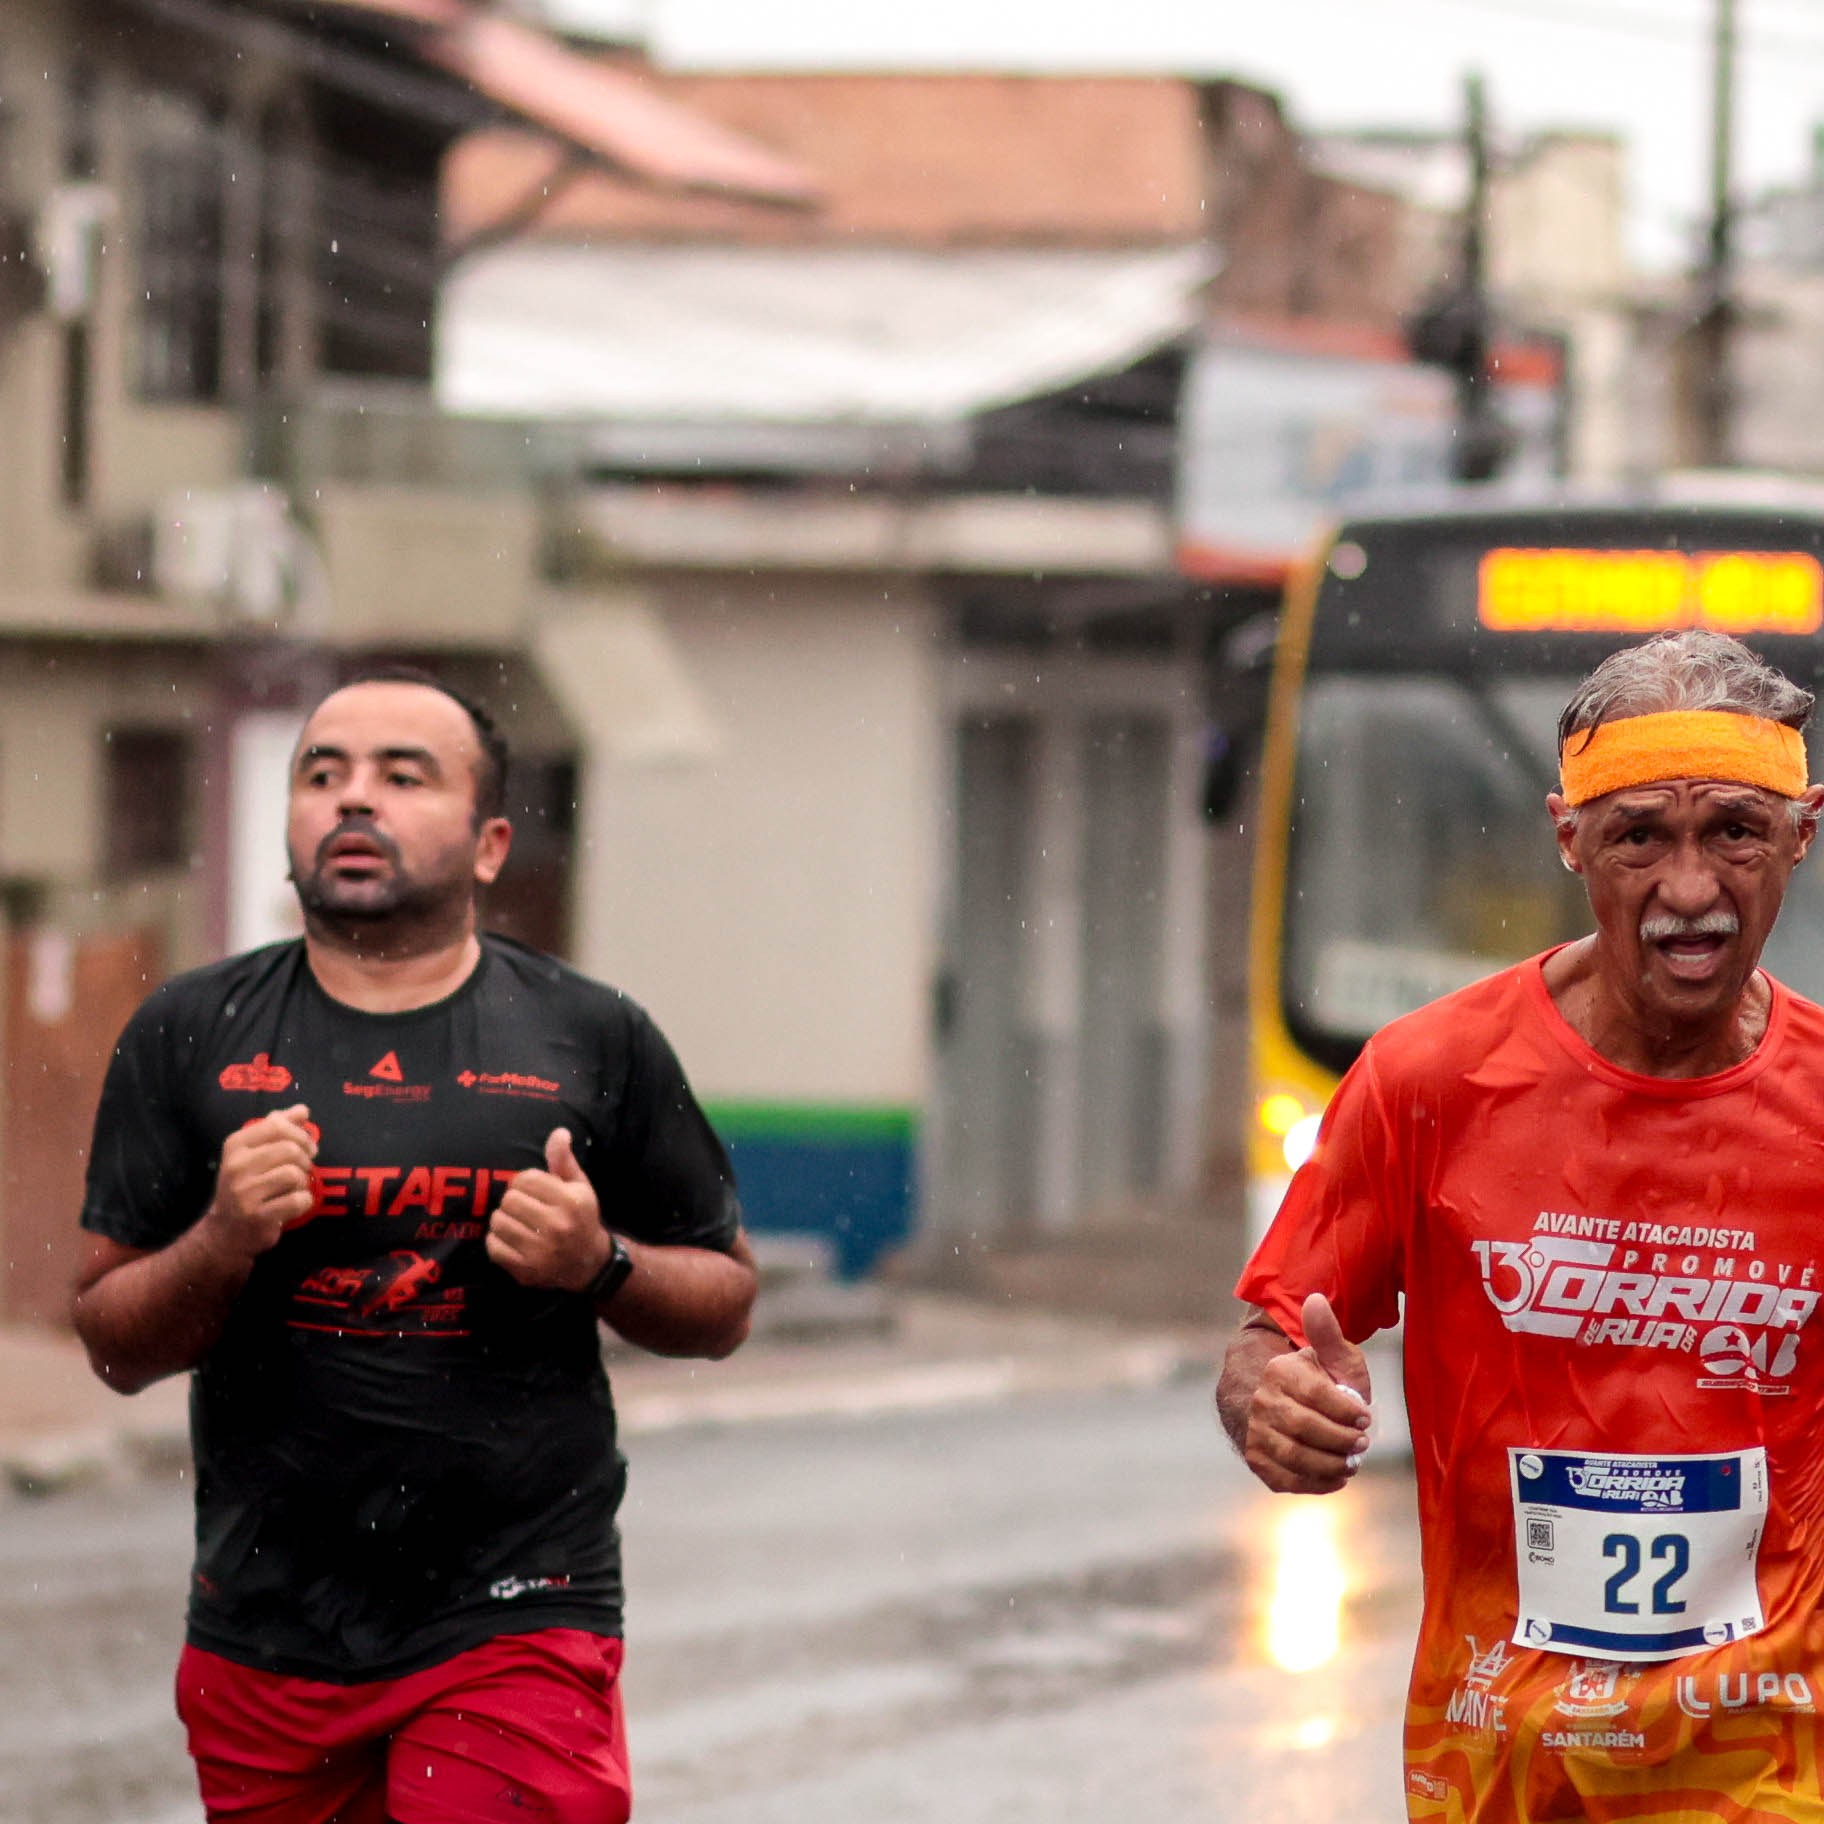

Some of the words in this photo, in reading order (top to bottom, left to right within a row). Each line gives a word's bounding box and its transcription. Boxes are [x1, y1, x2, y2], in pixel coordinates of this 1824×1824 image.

[1532, 1211, 1621, 1241] AVANTE
[1622, 1221, 1756, 1251] ATACADISTA
[1502, 1235, 1823, 1339] CORRIDA
[1622, 1250, 1817, 1288] PROMOVE
[1595, 1318, 1688, 1350] RUA
[1574, 1466, 1686, 1497] CORRIDA
[1602, 1532, 1690, 1615] 22
[1677, 1672, 1813, 1719] LUPO
[1541, 1729, 1645, 1748] SANTARÉM
